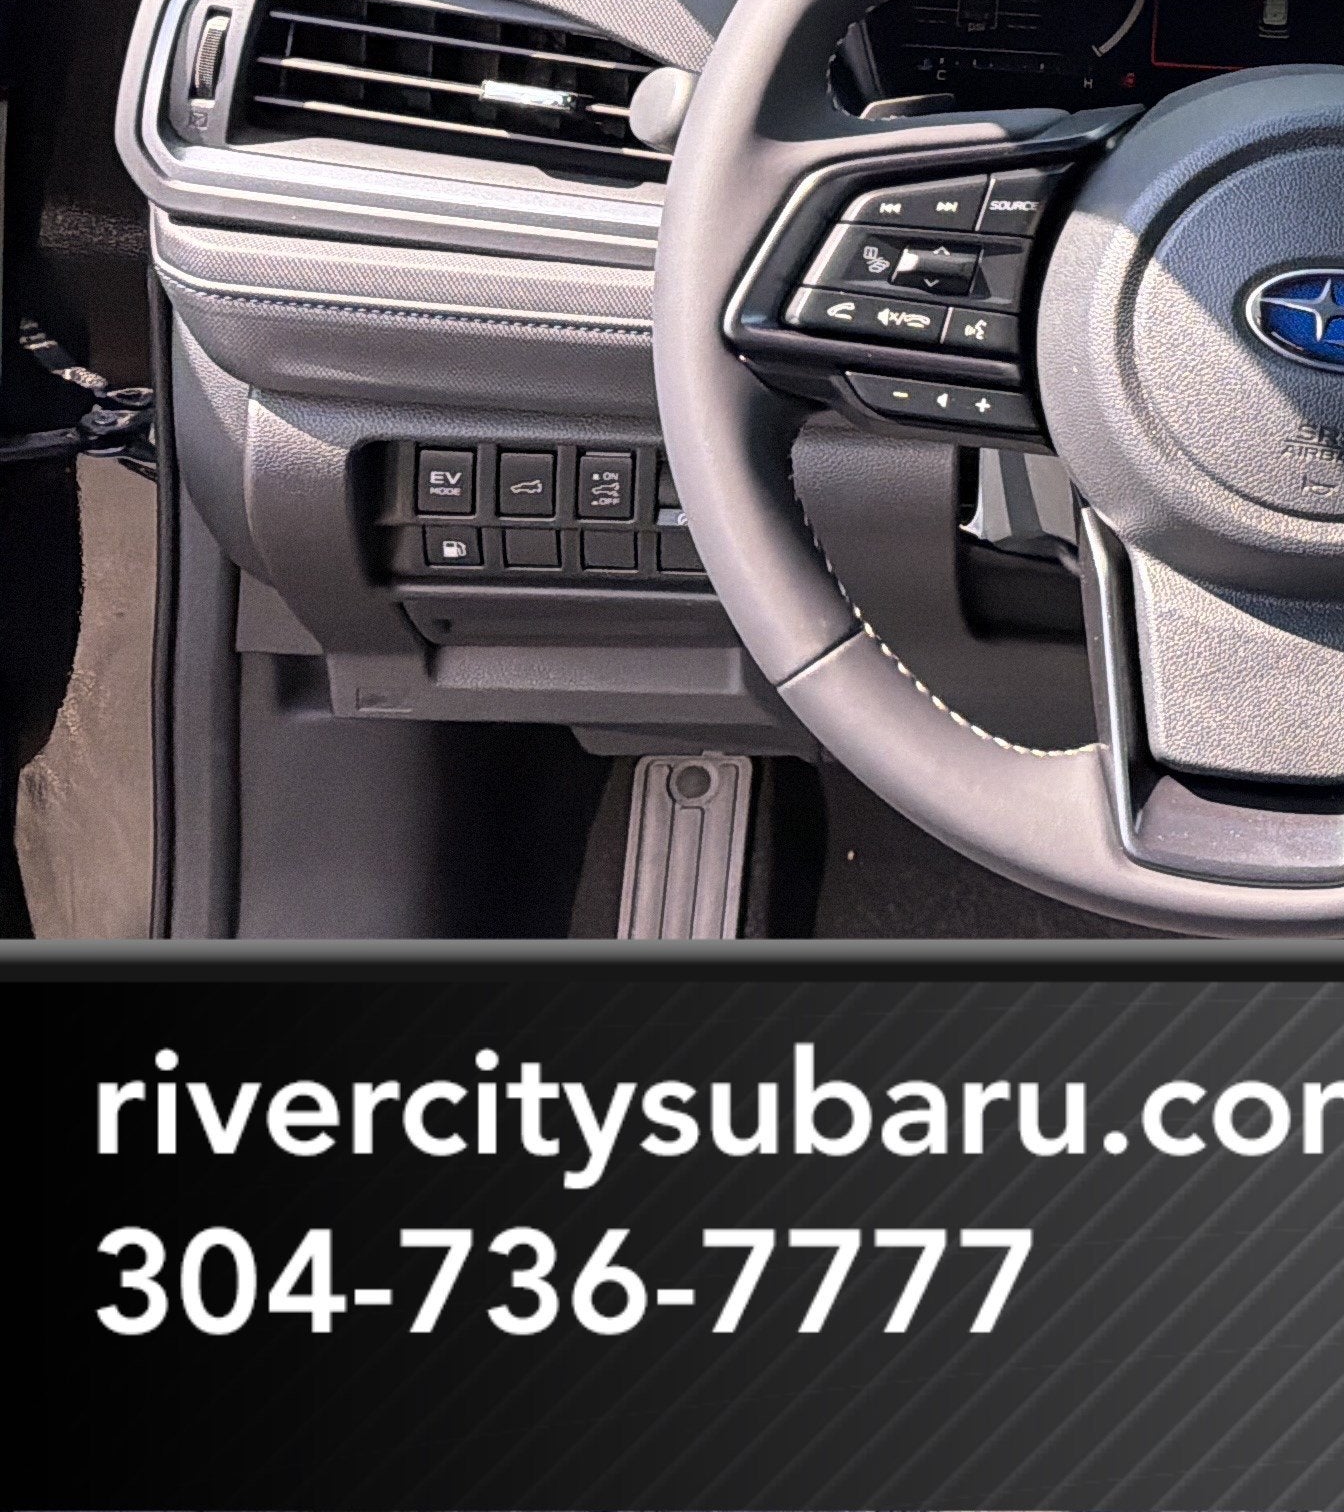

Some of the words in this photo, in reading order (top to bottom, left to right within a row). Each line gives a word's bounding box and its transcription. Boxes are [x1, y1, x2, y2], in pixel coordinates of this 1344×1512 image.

[989, 199, 1040, 212] SOURCE
[430, 471, 462, 485] EV
[602, 472, 619, 482] ON
[430, 487, 461, 497] MODE
